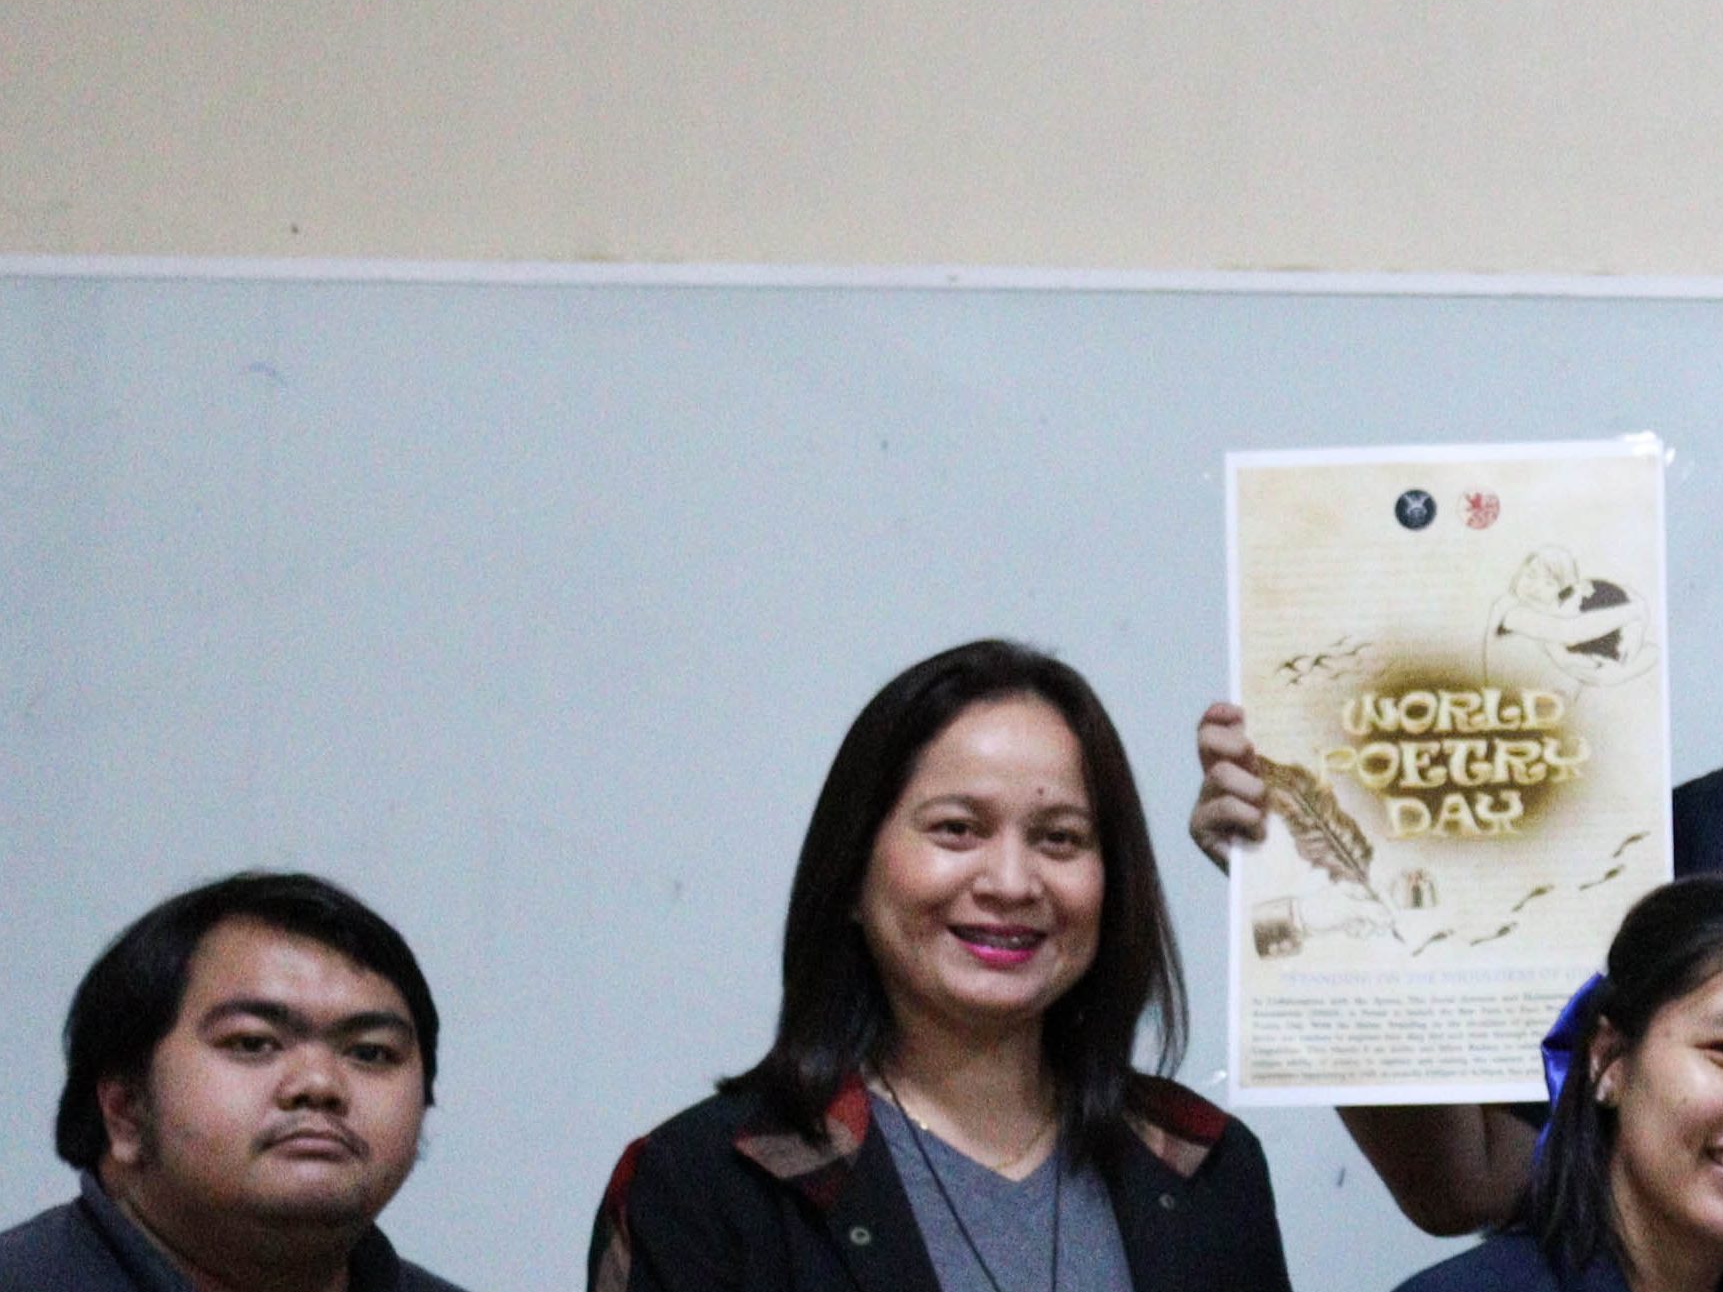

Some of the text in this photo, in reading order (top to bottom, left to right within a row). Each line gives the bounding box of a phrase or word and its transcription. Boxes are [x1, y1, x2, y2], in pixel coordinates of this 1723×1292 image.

[1342, 687, 1566, 735] WORLD
[1318, 735, 1592, 789] POETRY
[1384, 789, 1525, 839] DAY
